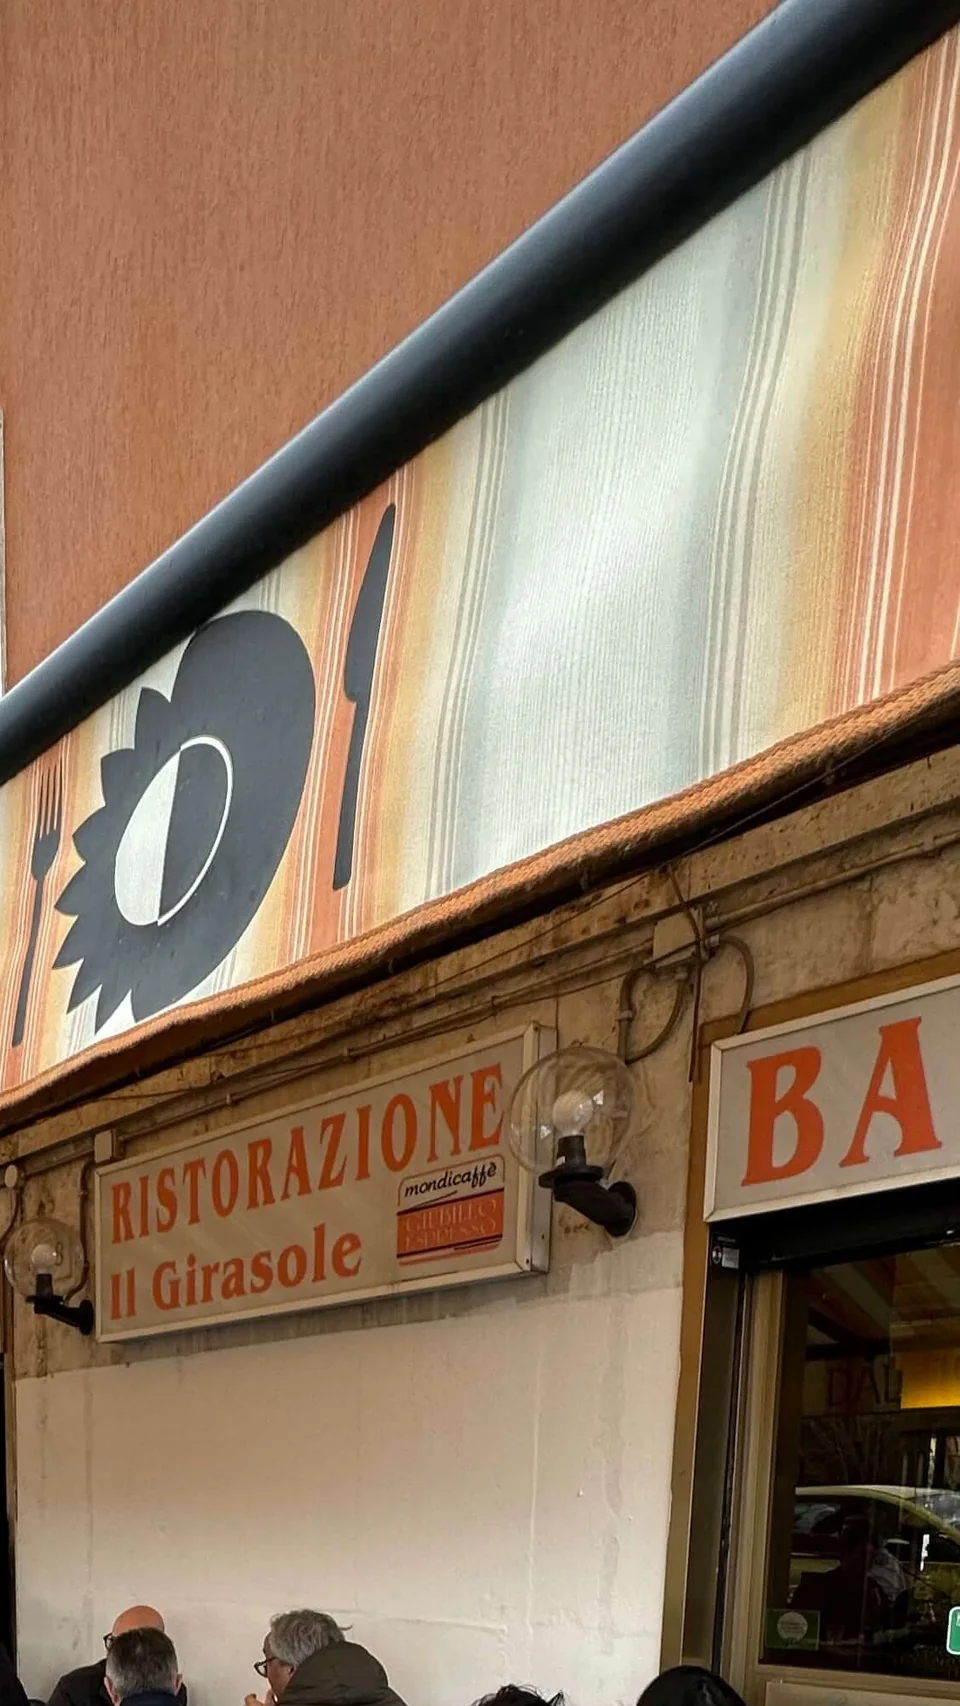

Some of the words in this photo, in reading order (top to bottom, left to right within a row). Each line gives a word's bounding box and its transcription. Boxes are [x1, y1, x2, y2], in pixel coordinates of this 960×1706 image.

[110, 1063, 505, 1246] RISTORAZIONE
[741, 1015, 943, 1188] BA
[404, 1161, 497, 1198] mondicaffè
[152, 1222, 364, 1312] Girasole
